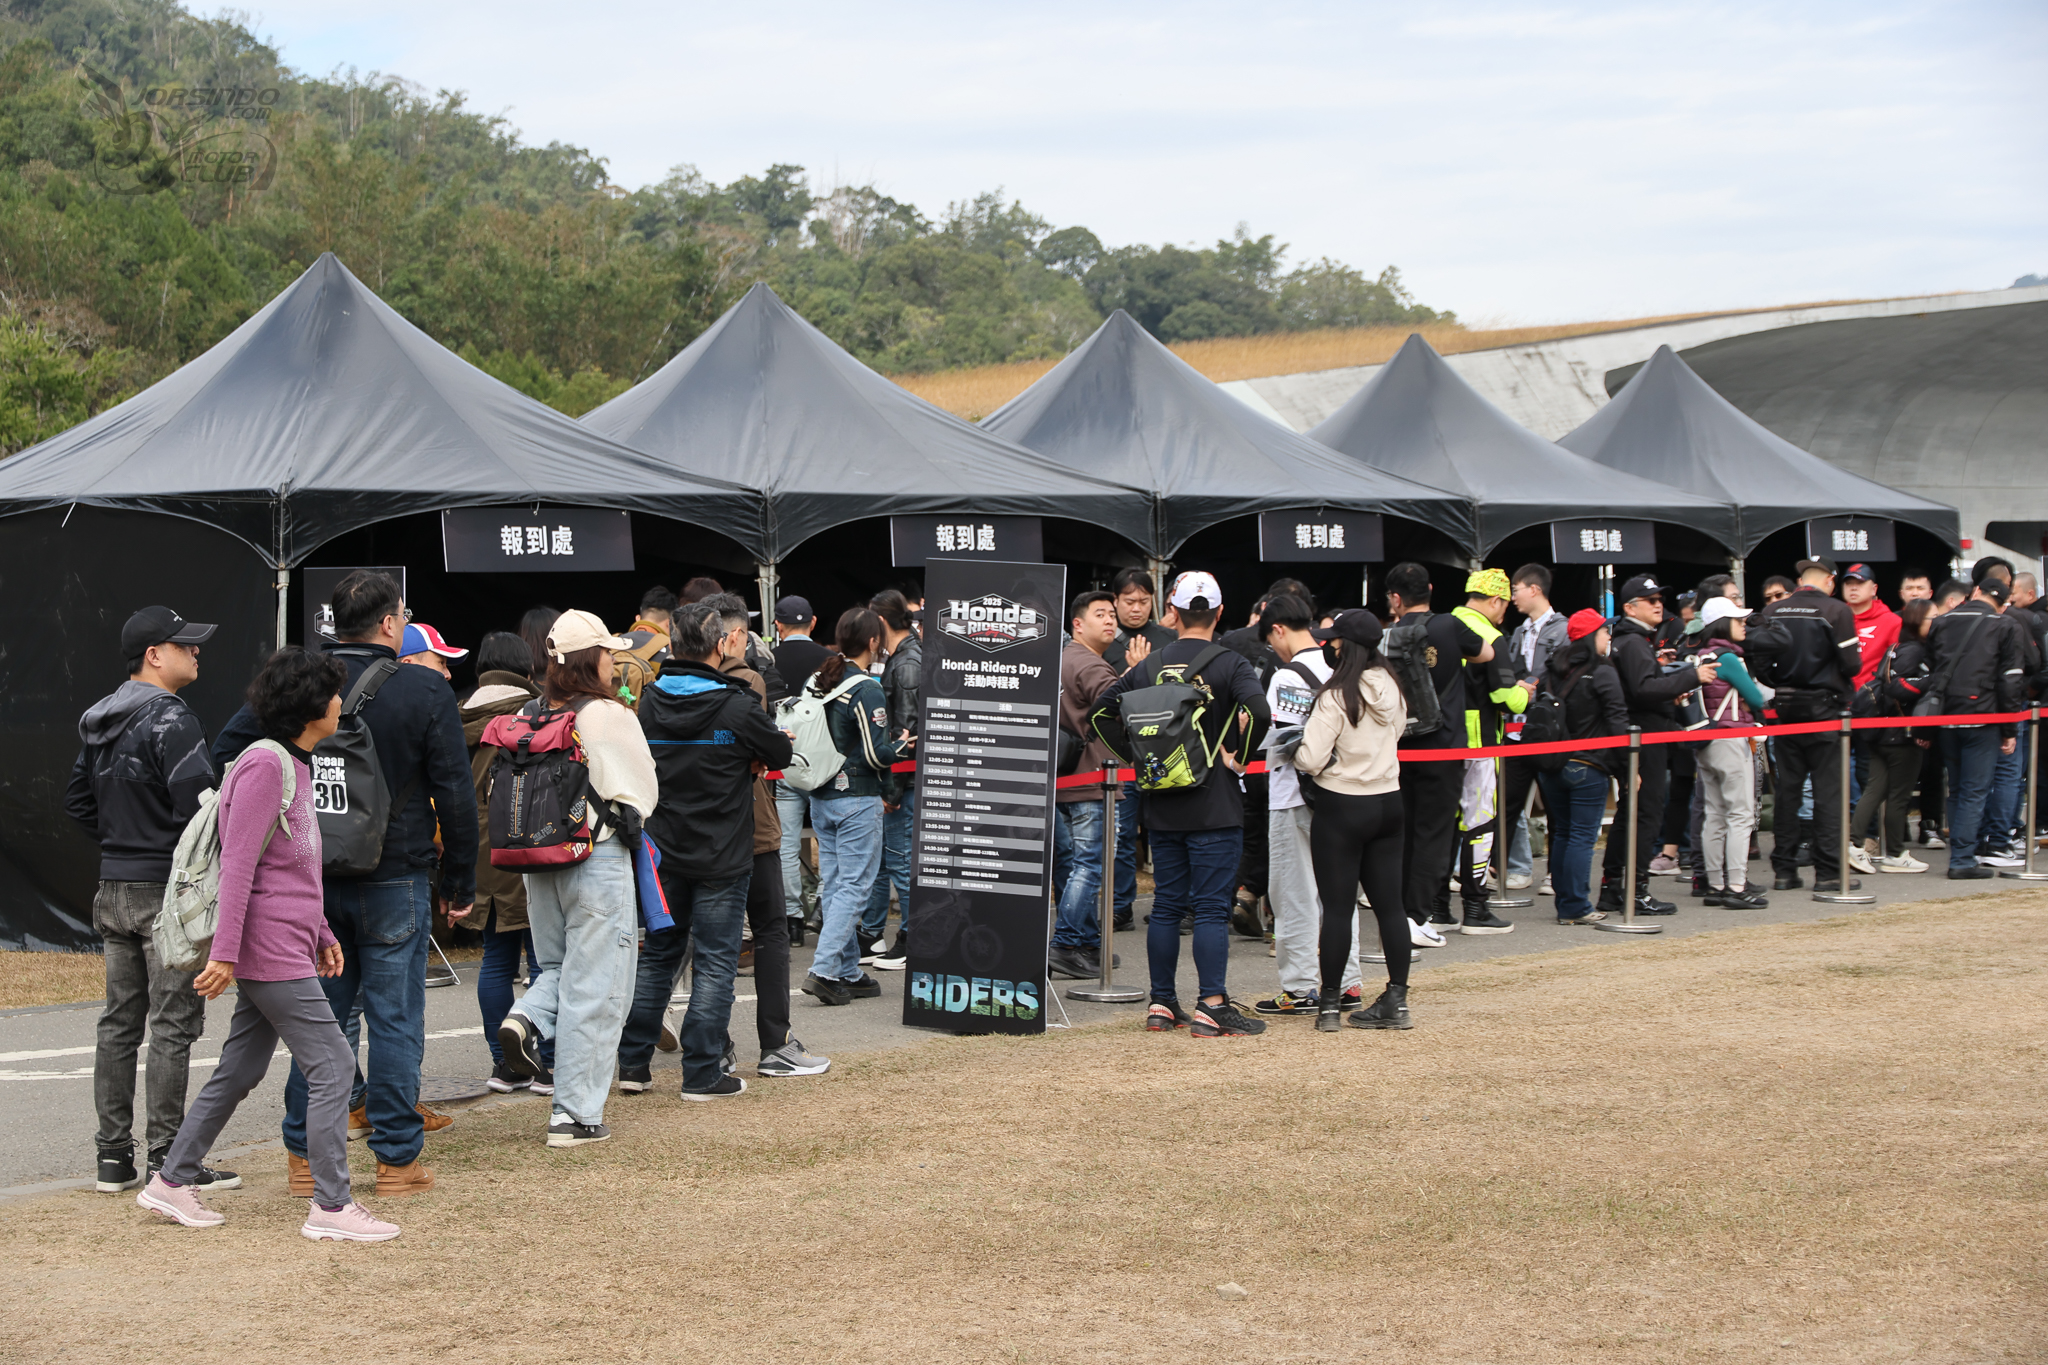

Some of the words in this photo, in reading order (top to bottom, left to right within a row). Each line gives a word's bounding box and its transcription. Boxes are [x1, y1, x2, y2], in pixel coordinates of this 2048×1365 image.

[500, 524, 575, 556] 報到處
[936, 523, 996, 552] 報到處
[1295, 523, 1345, 549] 報到處
[1580, 528, 1623, 552] 報到處
[948, 600, 1037, 624] Honda
[967, 621, 1017, 637] RIDERS
[942, 658, 979, 672] Honda
[980, 660, 1017, 674] Riders
[1018, 663, 1042, 678] Day
[963, 673, 1020, 690] 活動時程表
[1138, 724, 1159, 736] 46
[311, 754, 345, 767] Ocean
[313, 765, 346, 781] Pack
[315, 782, 346, 811] 30
[911, 971, 1040, 1020] RIDERS
